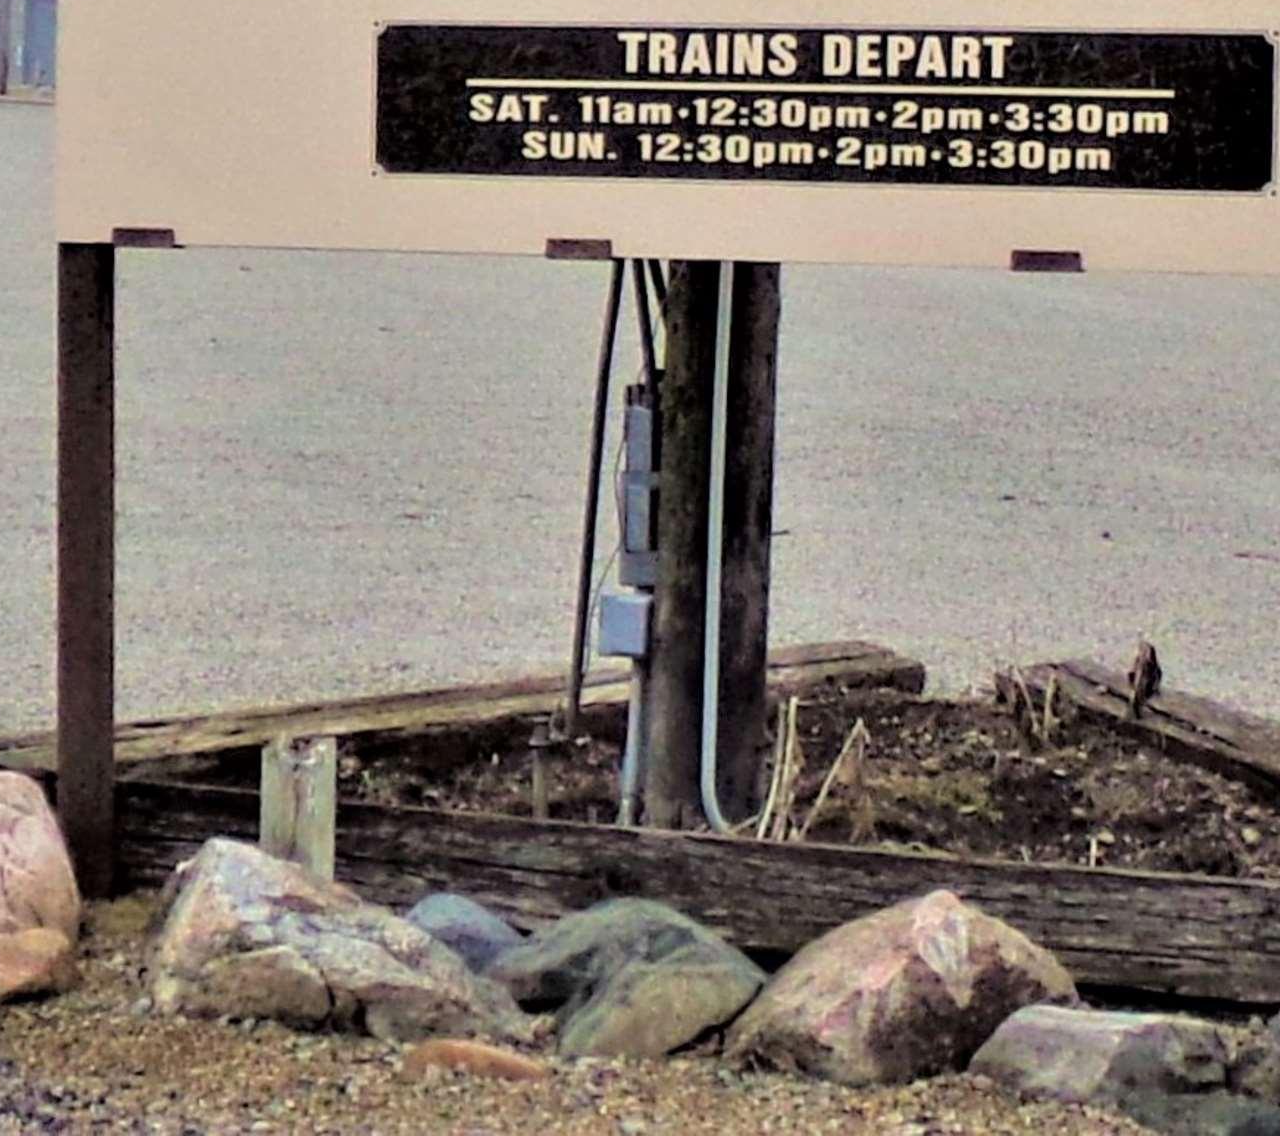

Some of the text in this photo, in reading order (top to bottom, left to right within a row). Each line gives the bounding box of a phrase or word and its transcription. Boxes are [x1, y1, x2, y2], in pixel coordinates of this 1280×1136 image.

[617, 32, 1014, 79] TRAINS DEPART
[469, 93, 560, 124] SAT.
[521, 131, 618, 161] SUN.
